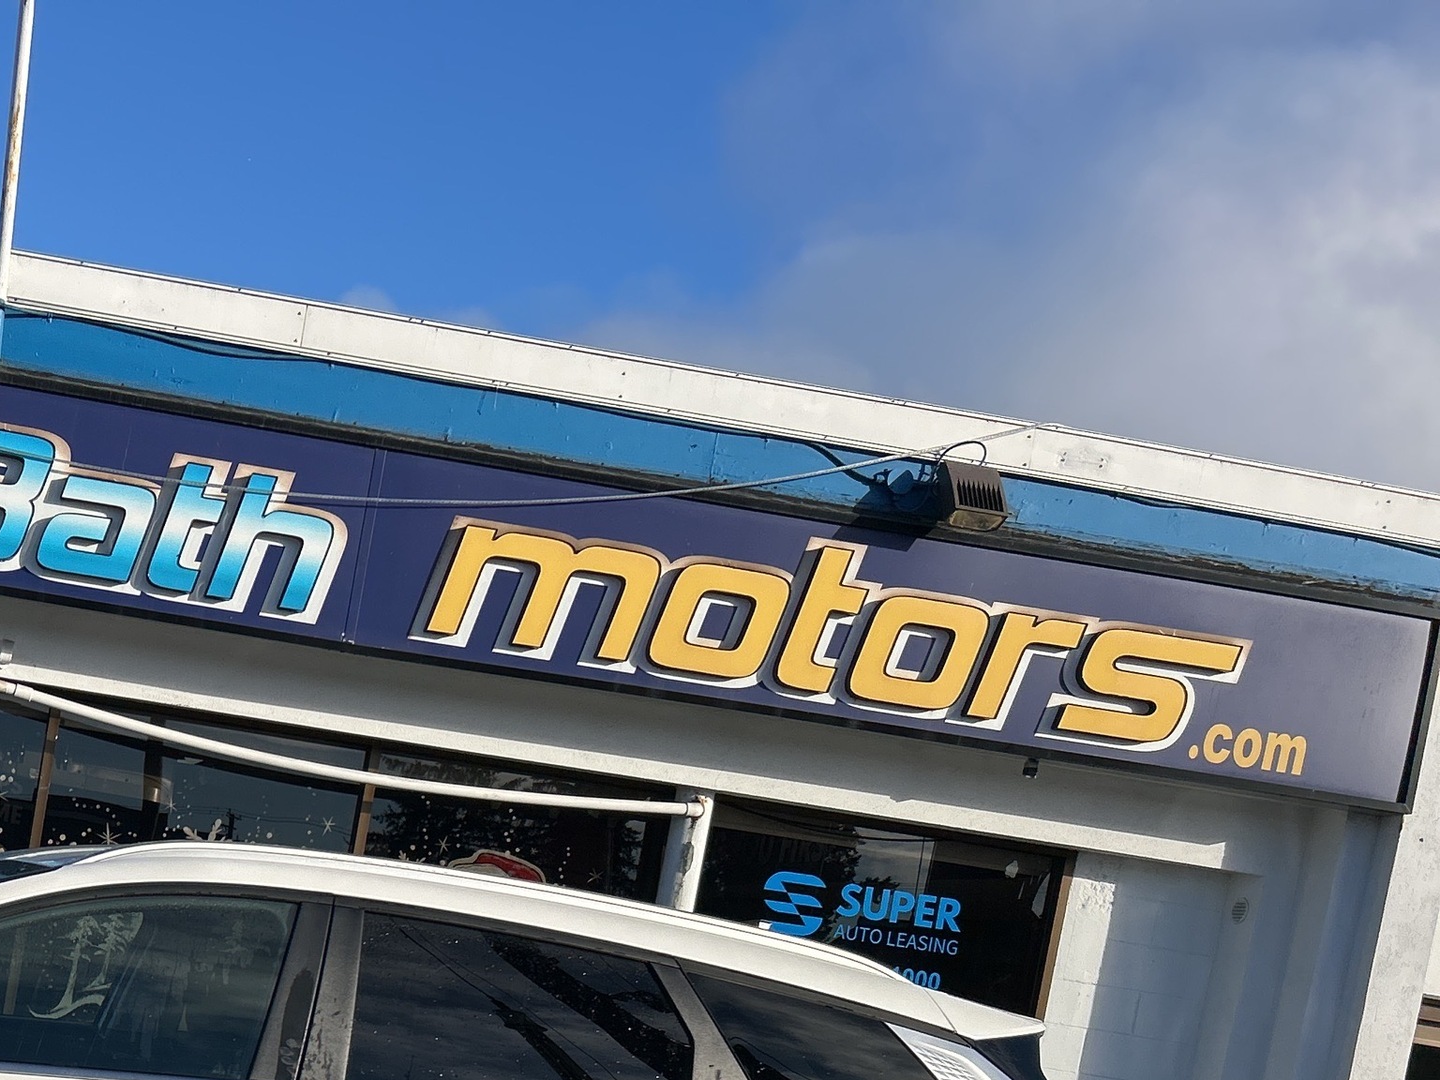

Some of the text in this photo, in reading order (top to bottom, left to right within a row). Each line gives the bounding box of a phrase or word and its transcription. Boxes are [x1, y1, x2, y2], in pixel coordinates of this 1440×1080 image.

[408, 515, 1252, 752] motors
[1188, 723, 1307, 776] .com
[836, 883, 961, 933] SUPER
[833, 923, 959, 956] AUTO LEASING
